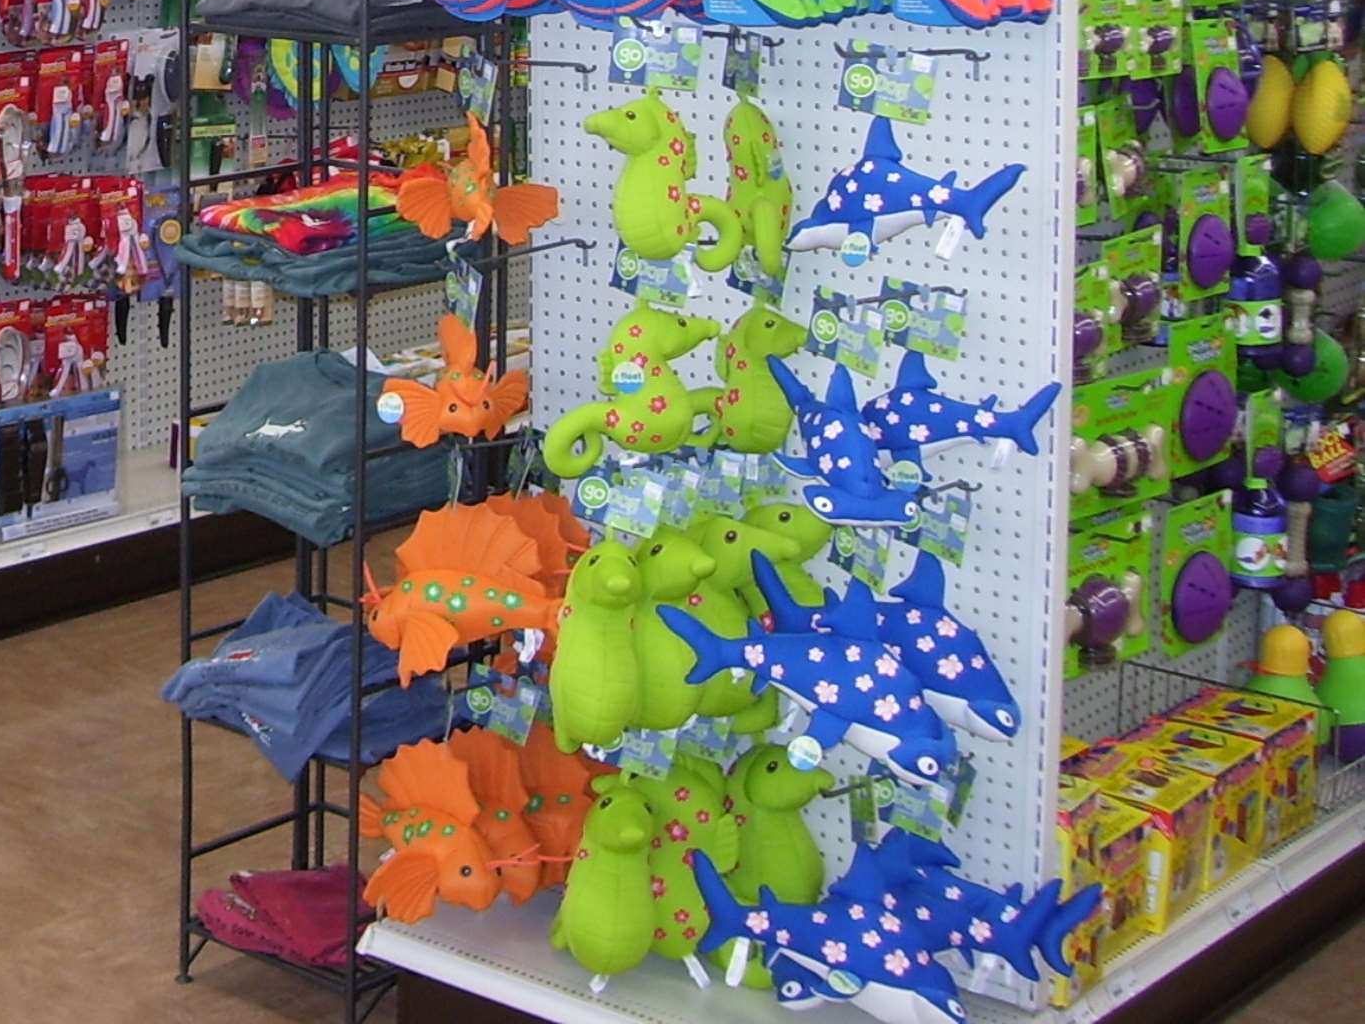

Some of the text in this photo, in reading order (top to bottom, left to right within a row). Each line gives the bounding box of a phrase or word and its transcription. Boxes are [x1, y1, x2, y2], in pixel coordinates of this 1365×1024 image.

[619, 47, 643, 65] go
[849, 72, 873, 89] go
[584, 484, 606, 501] go
